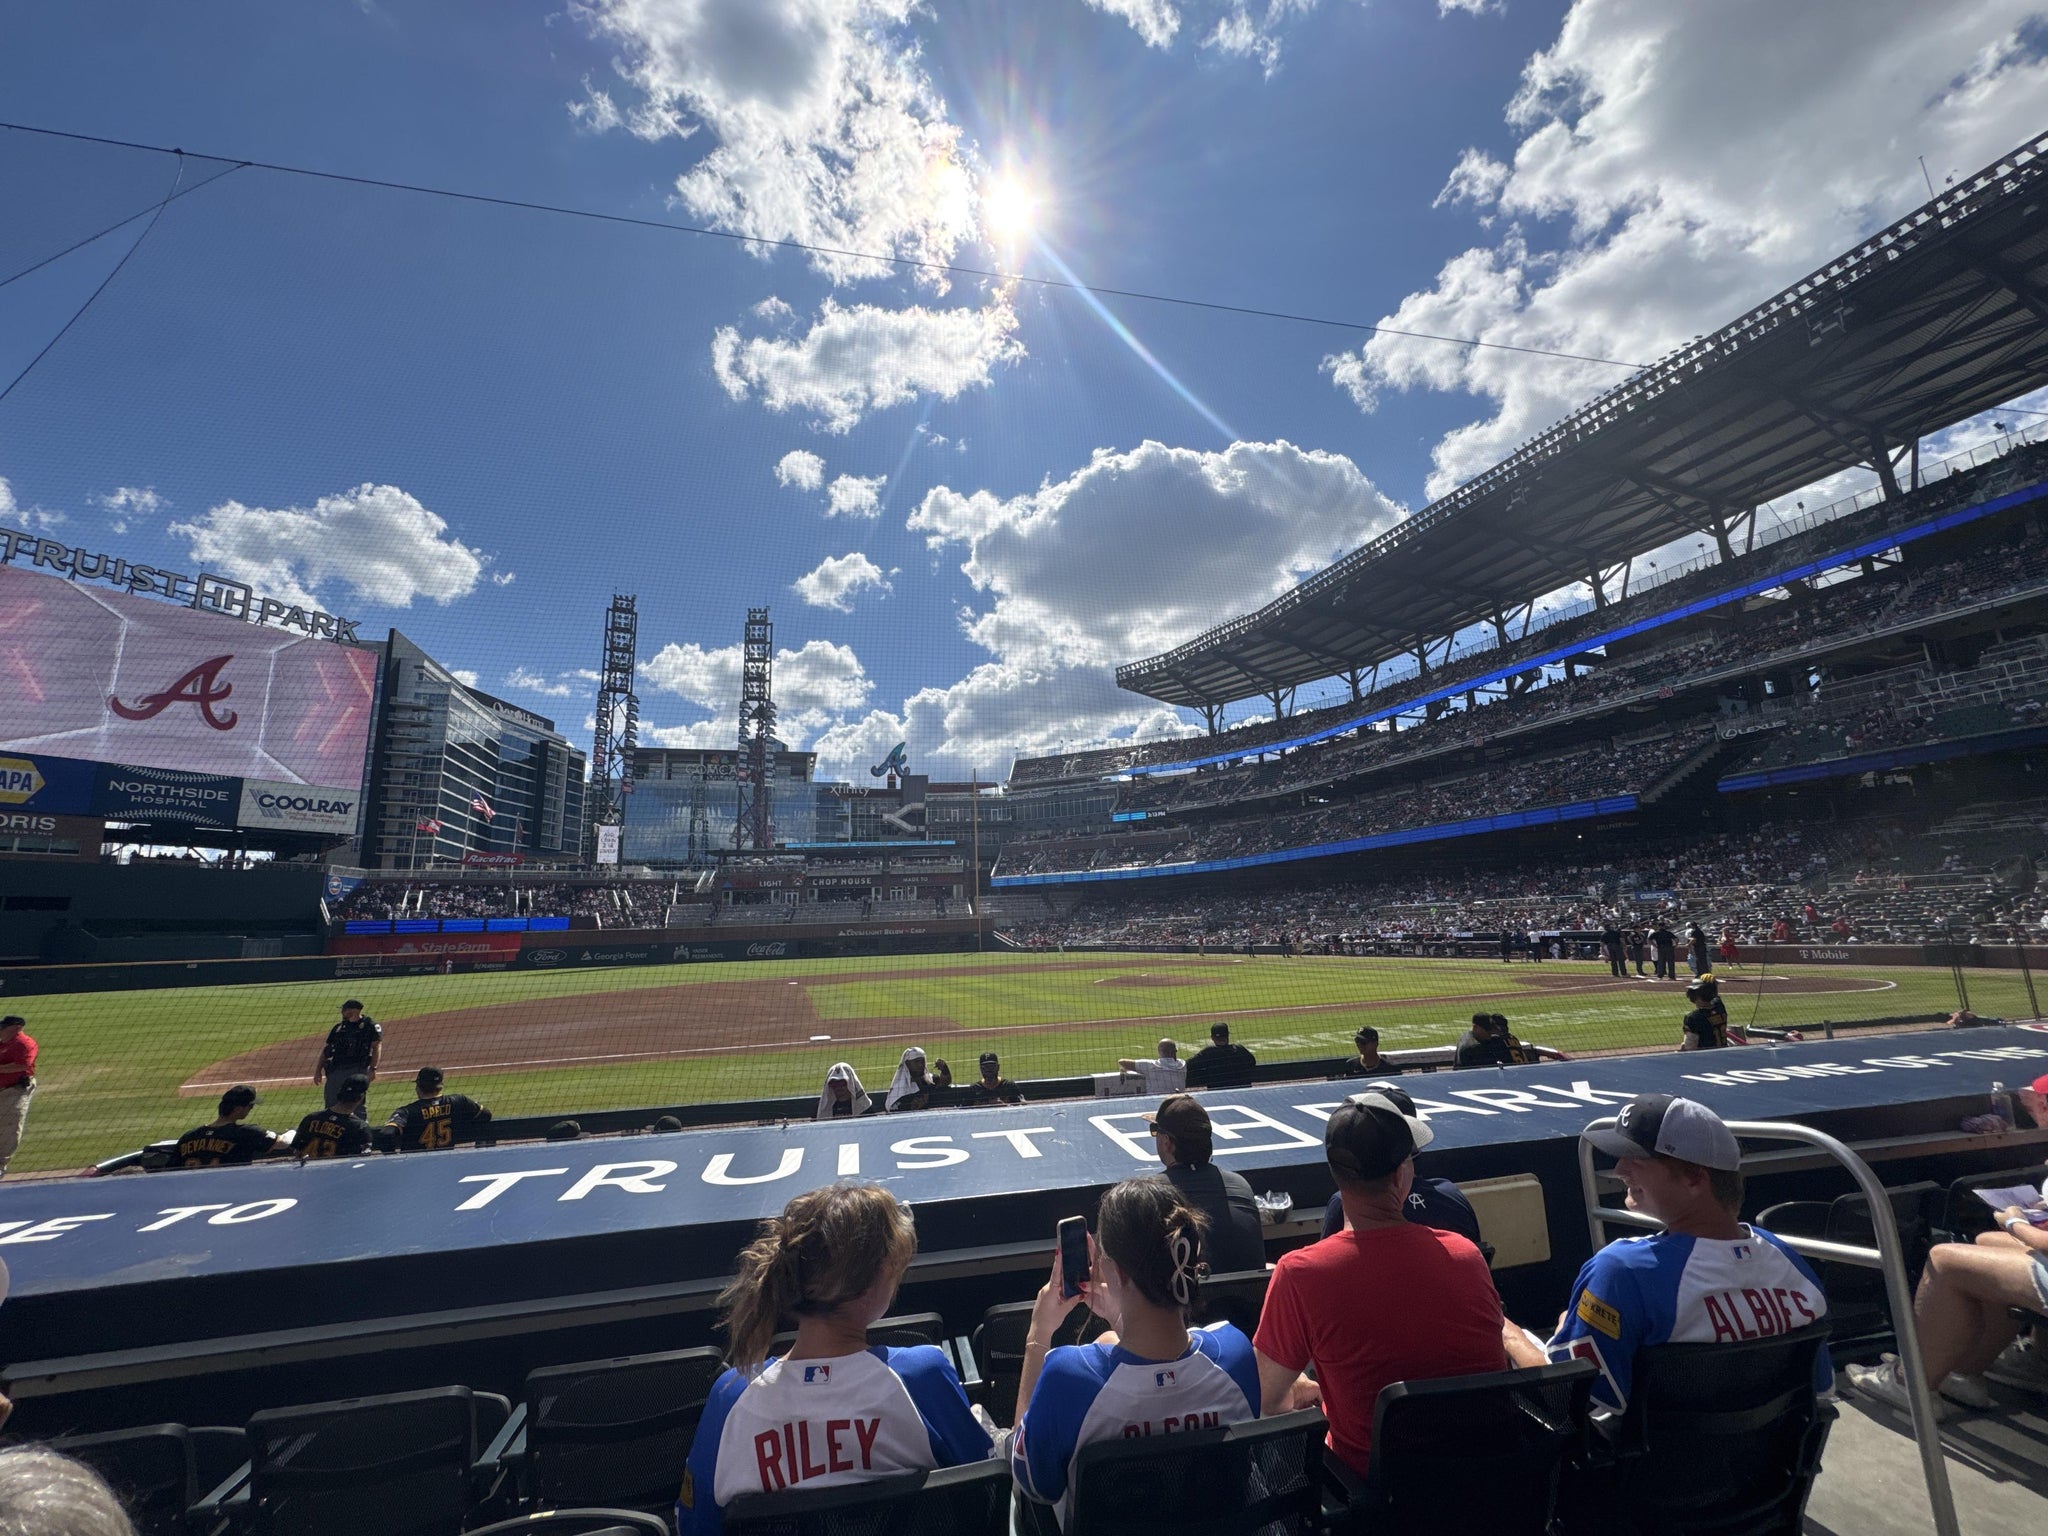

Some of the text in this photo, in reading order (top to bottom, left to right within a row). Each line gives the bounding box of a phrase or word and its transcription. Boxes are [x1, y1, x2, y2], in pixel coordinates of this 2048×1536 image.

[0, 528, 361, 643] TRUIST PARK
[108, 780, 230, 801] NORTHSIDE
[130, 795, 207, 809] HOSPITAL
[259, 794, 355, 814] COOLRAY
[467, 854, 517, 863] RaceTrac
[812, 877, 872, 886] CHOP HOUSE
[594, 951, 648, 961] Georgia Power
[747, 942, 786, 956] Coca-Cola
[1810, 949, 1850, 960] Mobile
[1680, 1063, 1885, 1086] HOME
[1861, 1055, 1953, 1068] OF
[309, 1119, 346, 1139] FLORES
[418, 1119, 452, 1150] 45
[453, 1126, 1056, 1212] TRUIST
[137, 1198, 298, 1232] TO
[1703, 1287, 1816, 1342] ALBIES
[754, 1418, 880, 1494] RILEY
